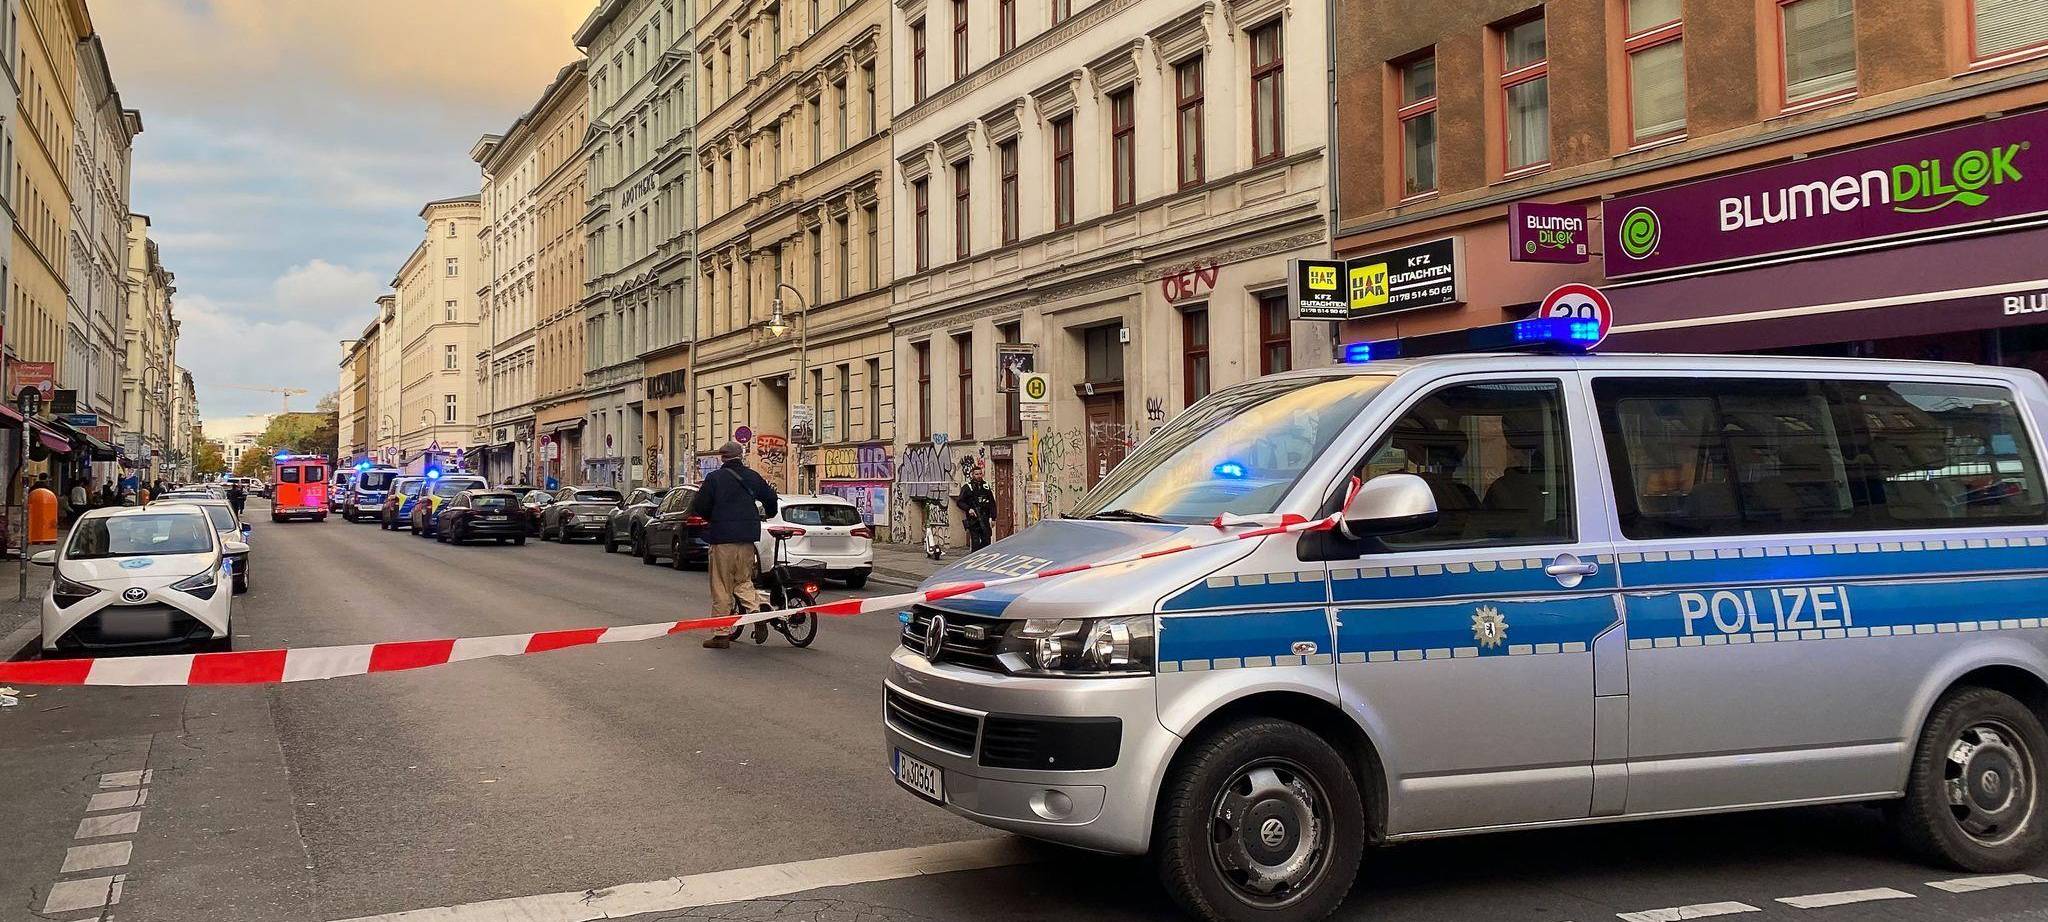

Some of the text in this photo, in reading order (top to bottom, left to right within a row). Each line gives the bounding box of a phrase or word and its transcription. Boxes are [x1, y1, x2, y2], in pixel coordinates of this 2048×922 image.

[1408, 254, 1431, 267] KFZ
[1310, 271, 1335, 285] HAK
[1389, 264, 1452, 284] GUTACHTEN
[1353, 271, 1386, 301] HAK
[1389, 285, 1453, 303] 0178 514 50 69
[1031, 382, 1042, 395] H
[952, 552, 1054, 577] POLIZEI
[1679, 585, 1852, 636] POLIZEI
